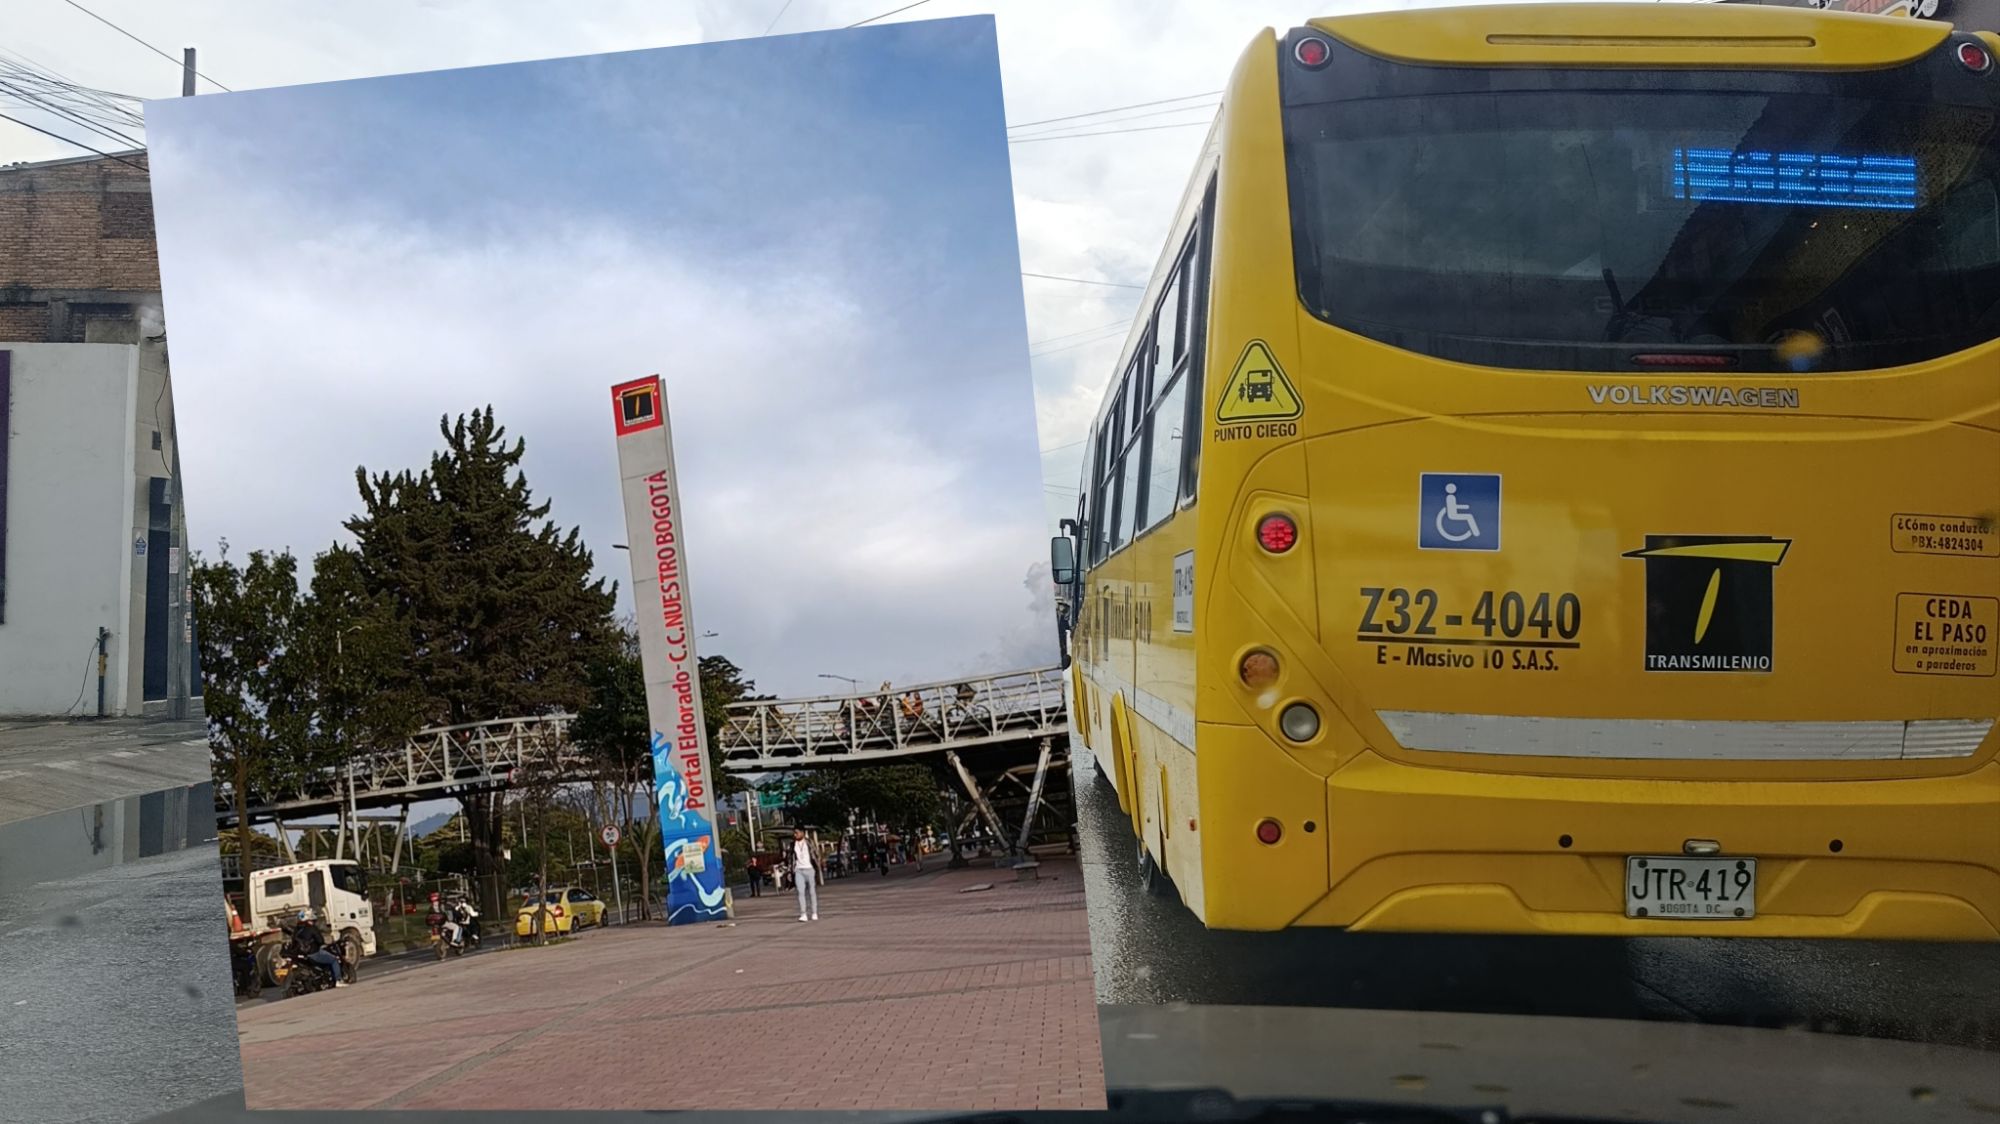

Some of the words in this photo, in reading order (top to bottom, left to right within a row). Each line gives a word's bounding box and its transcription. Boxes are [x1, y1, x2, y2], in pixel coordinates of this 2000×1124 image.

[1587, 384, 1800, 408] VOLKSWAGEN
[1214, 425, 1252, 442] PUNTO
[1256, 422, 1297, 439] CIEGO
[1897, 518, 1936, 532] ¿Cómo
[1926, 598, 1972, 619] CEDA
[1914, 622, 1934, 641] EL
[1941, 623, 1987, 644] PASO
[1377, 645, 1387, 665] E
[1406, 646, 1474, 668] Masivo
[1512, 650, 1559, 671] S.A.S.
[1906, 645, 1918, 654] en
[1922, 644, 1988, 657] aproximación
[1648, 654, 1770, 669] TRANSMILENIO
[1916, 660, 1923, 668] a
[1926, 658, 1976, 671] paraderos
[672, 671, 698, 750] Eldorado
[681, 753, 705, 809] Portal
[1659, 903, 1699, 914] BOGOTA
